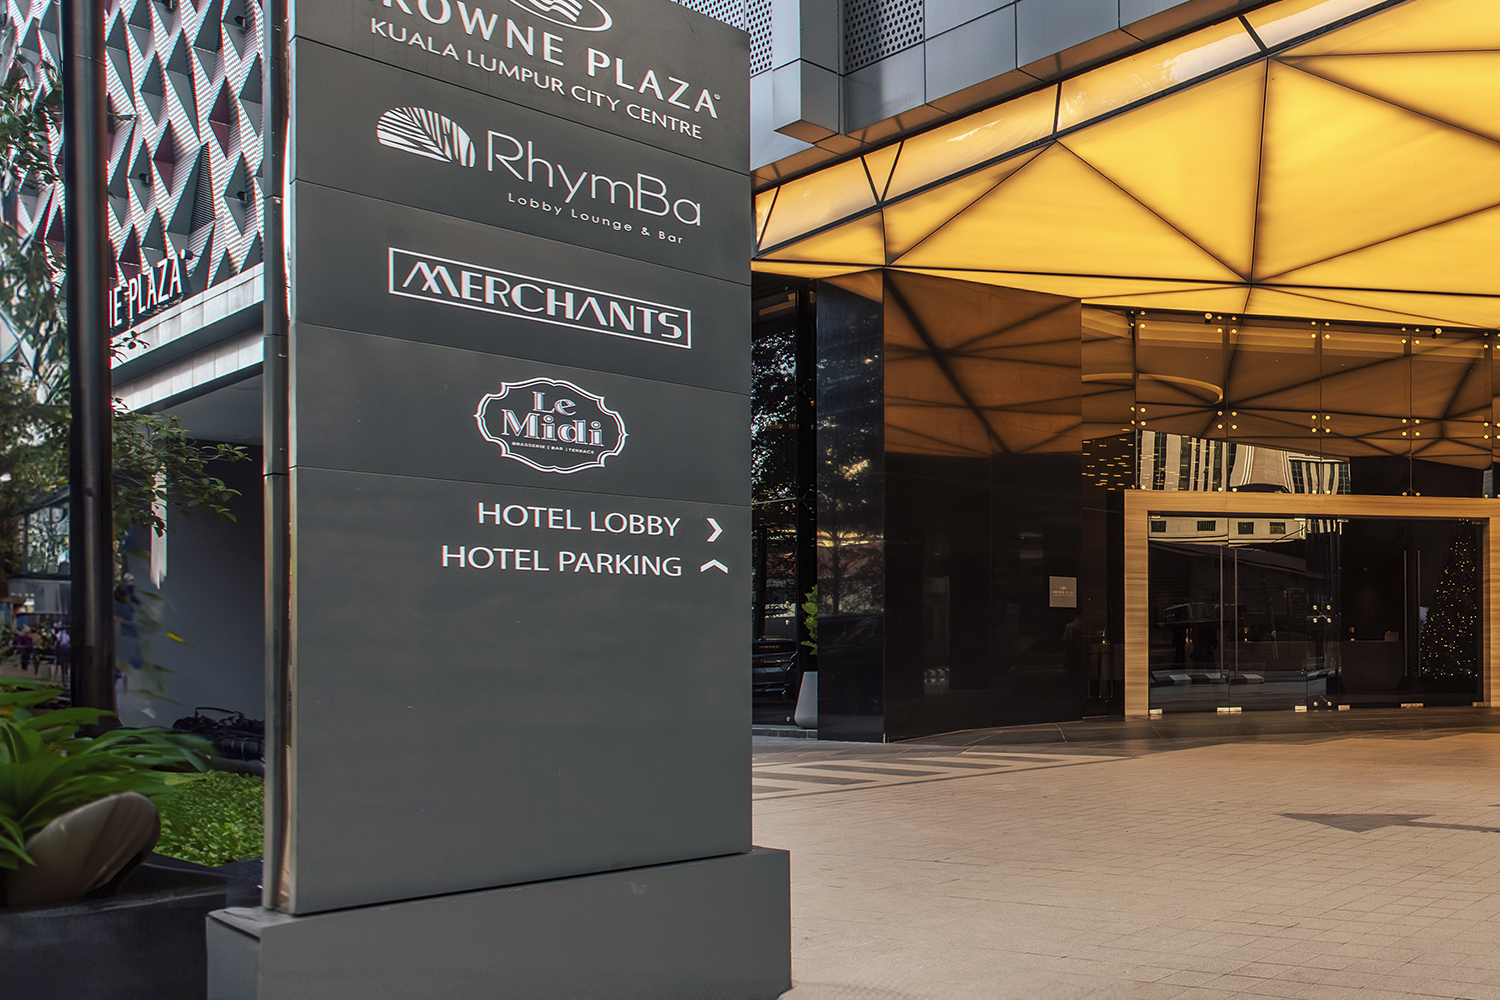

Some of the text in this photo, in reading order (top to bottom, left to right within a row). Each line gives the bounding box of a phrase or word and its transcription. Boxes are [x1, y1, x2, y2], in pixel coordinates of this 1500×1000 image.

[371, 17, 703, 140] KUALA LUMPUR CITY CENTRE
[487, 130, 702, 227] RhymBa
[507, 192, 684, 244] Lobby Lounge & Bar
[128, 252, 183, 320] PLAZA
[402, 261, 683, 340] MERCHANTS
[501, 408, 605, 447] Midi
[532, 390, 577, 416] Le
[478, 502, 682, 537] HOTEL LOBBY
[442, 545, 682, 577] HOTEL PARKING
